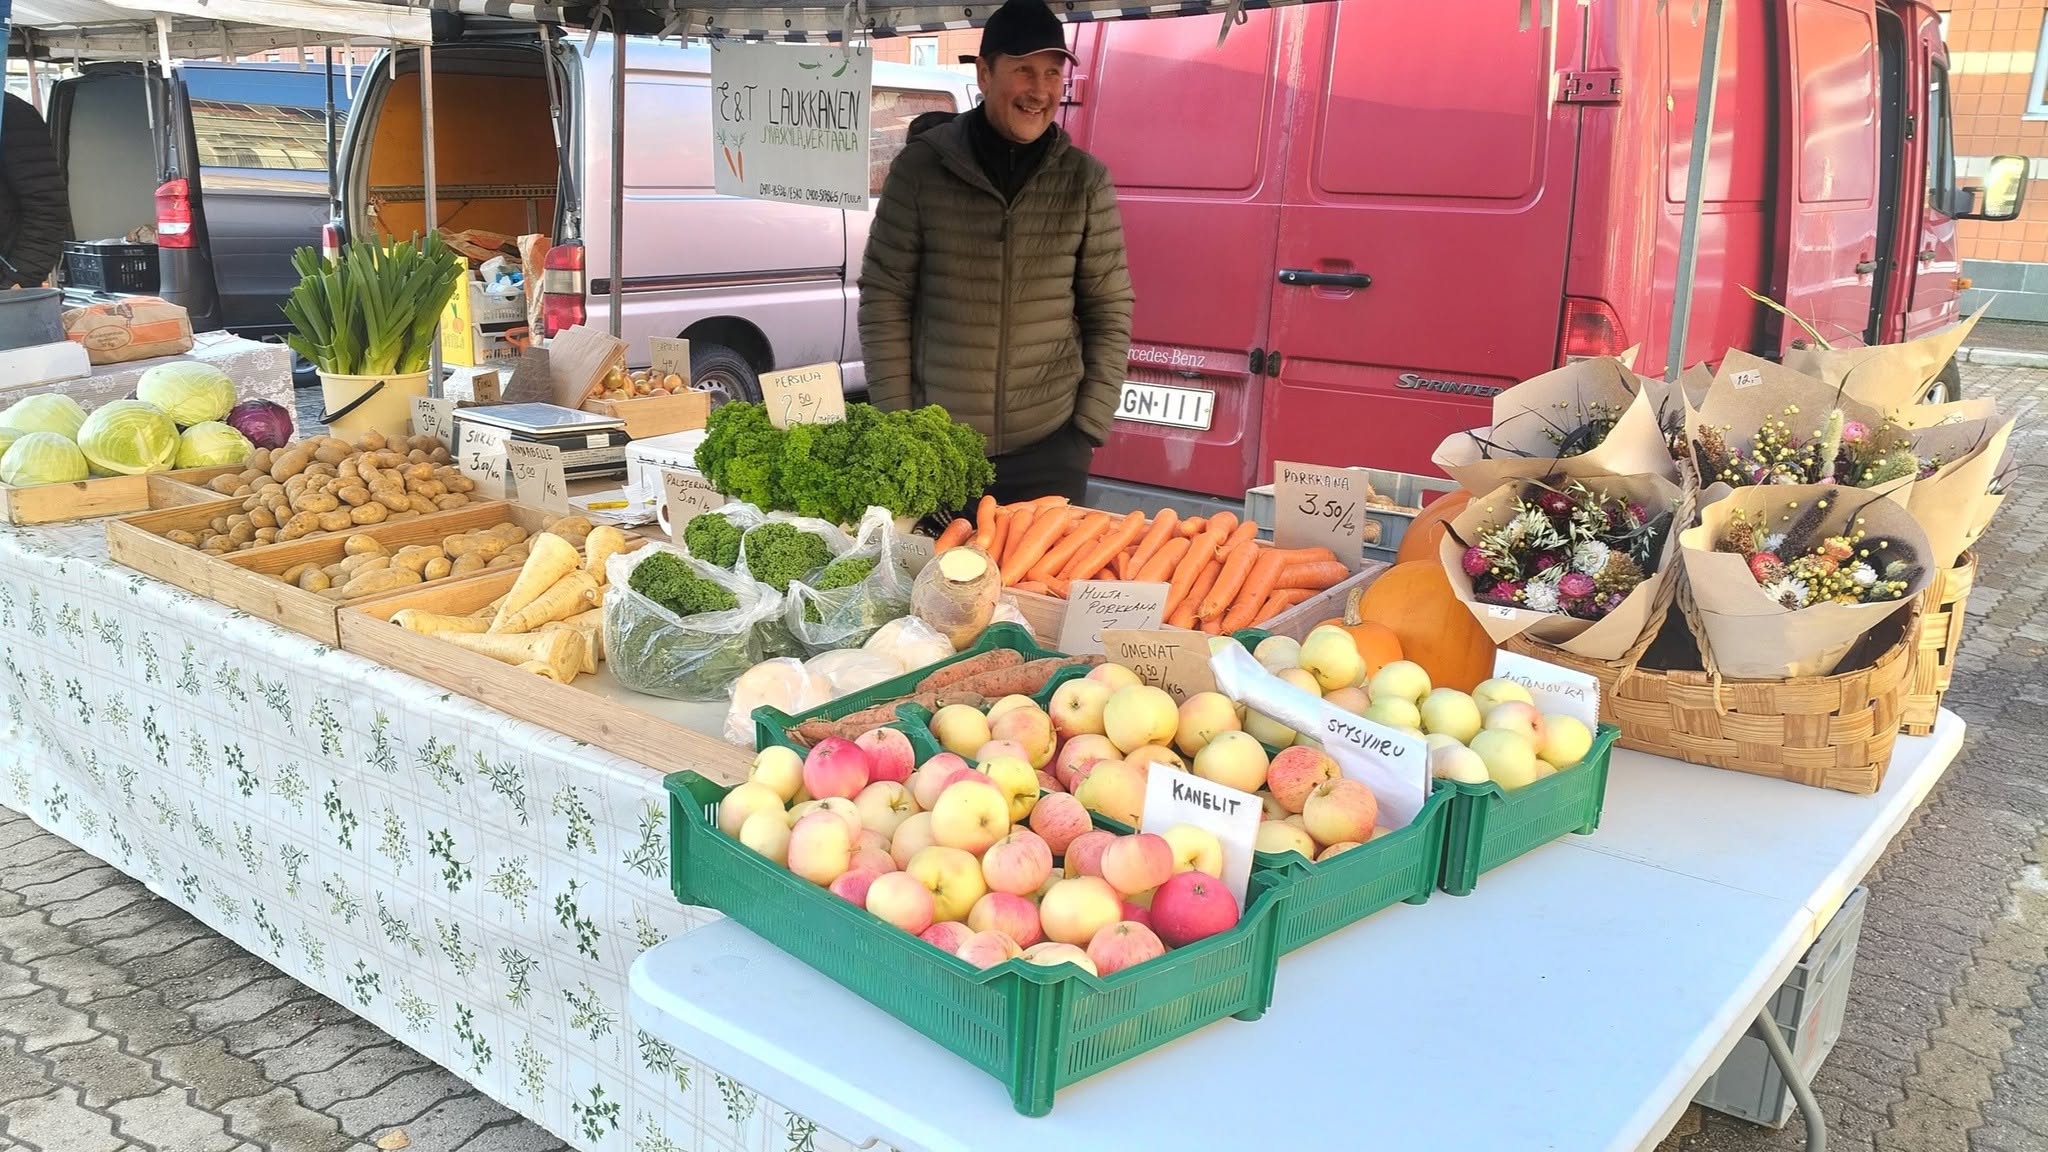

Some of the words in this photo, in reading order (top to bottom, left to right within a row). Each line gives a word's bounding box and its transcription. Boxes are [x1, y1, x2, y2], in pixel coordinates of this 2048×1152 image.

[717, 82, 758, 122] E&T
[769, 88, 861, 130] LAUKKANEN
[1127, 347, 1206, 367] rcedes-Benz
[1395, 373, 1504, 398] SPRINTER
[1123, 389, 1201, 422] GN-111
[509, 444, 553, 460] ANNABELLE
[1284, 468, 1350, 490] PORKKANA
[1079, 584, 1130, 600] MULTA-
[1086, 600, 1158, 615] PORKKANA
[1120, 643, 1181, 661] OMENAT
[1172, 779, 1242, 816] KANELIT
